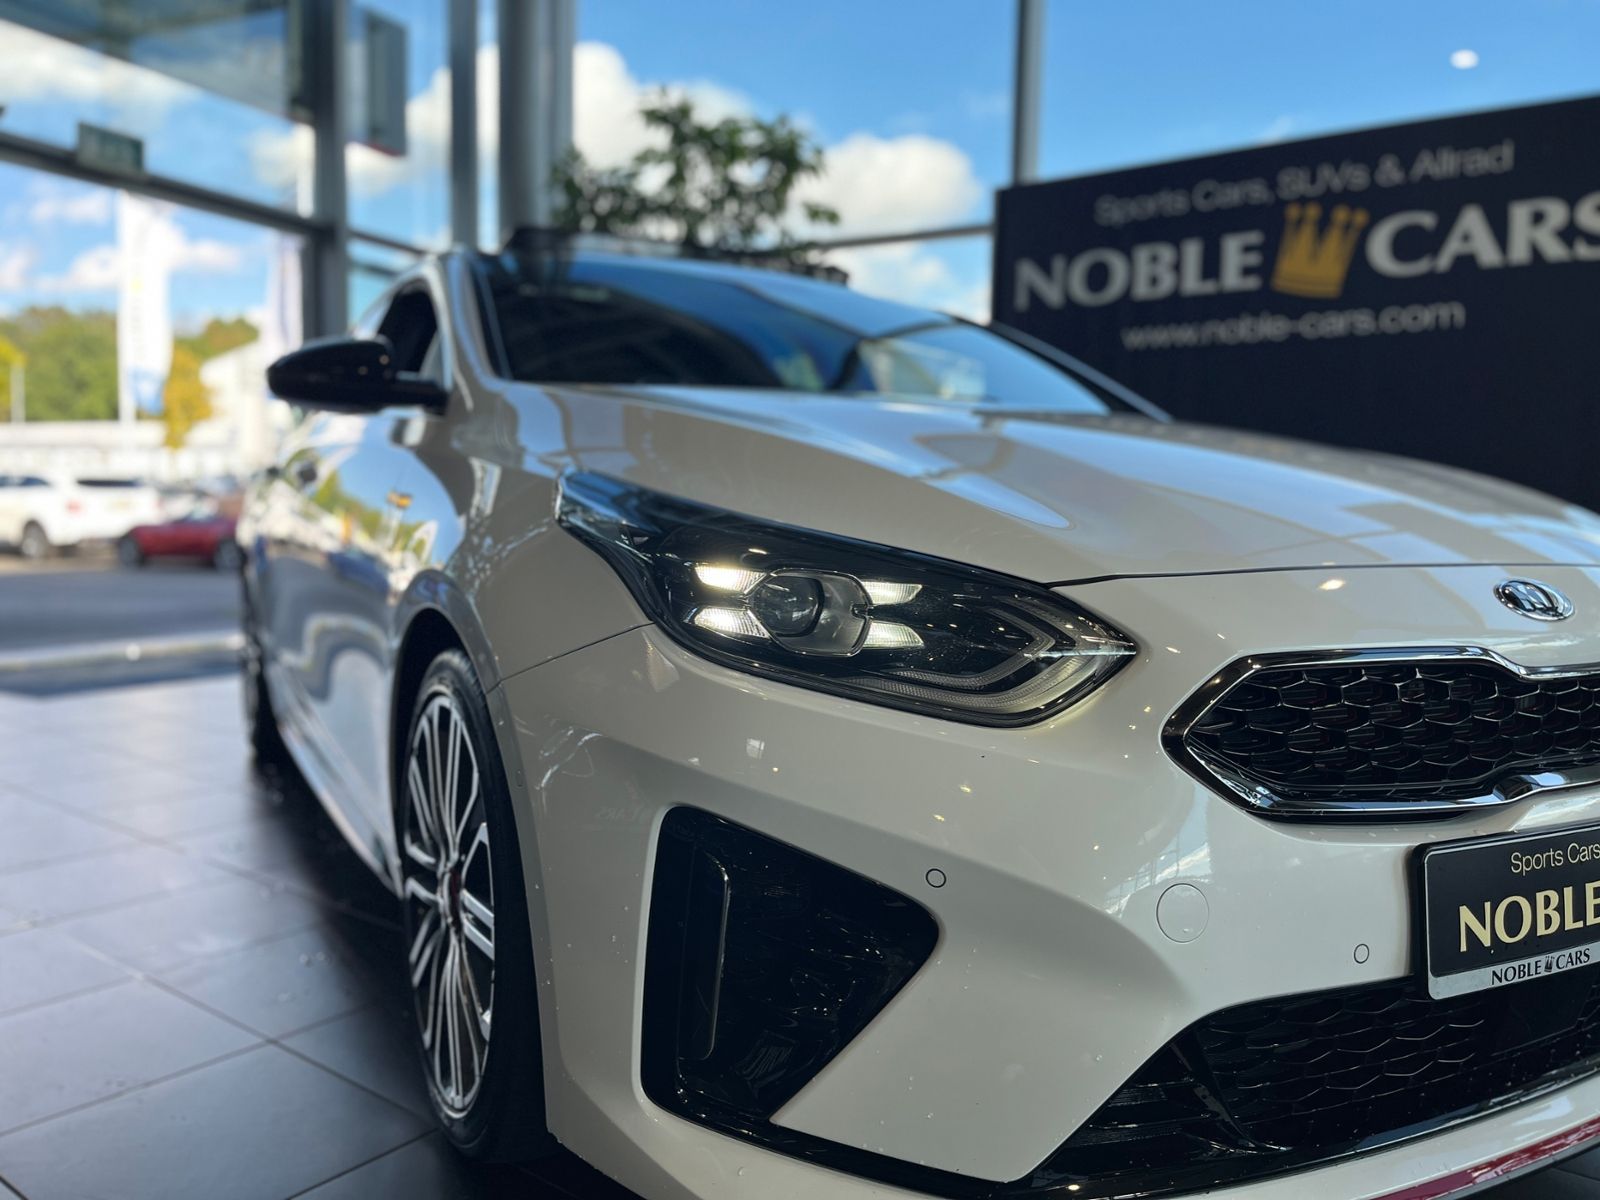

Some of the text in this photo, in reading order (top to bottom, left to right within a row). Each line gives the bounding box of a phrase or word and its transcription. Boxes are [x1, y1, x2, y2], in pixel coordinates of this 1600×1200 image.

[1095, 189, 1190, 226] Sports
[1278, 161, 1371, 201] SUVs
[1376, 154, 1404, 187] &
[1410, 139, 1515, 180] Allrad
[1014, 192, 1600, 311] NOBLE CARS
[1122, 301, 1465, 350] www.noble-cars.com
[1511, 842, 1600, 876] Sports Cars
[1459, 880, 1600, 952] NOBLE
[1491, 948, 1591, 985] NOBLE CARS
